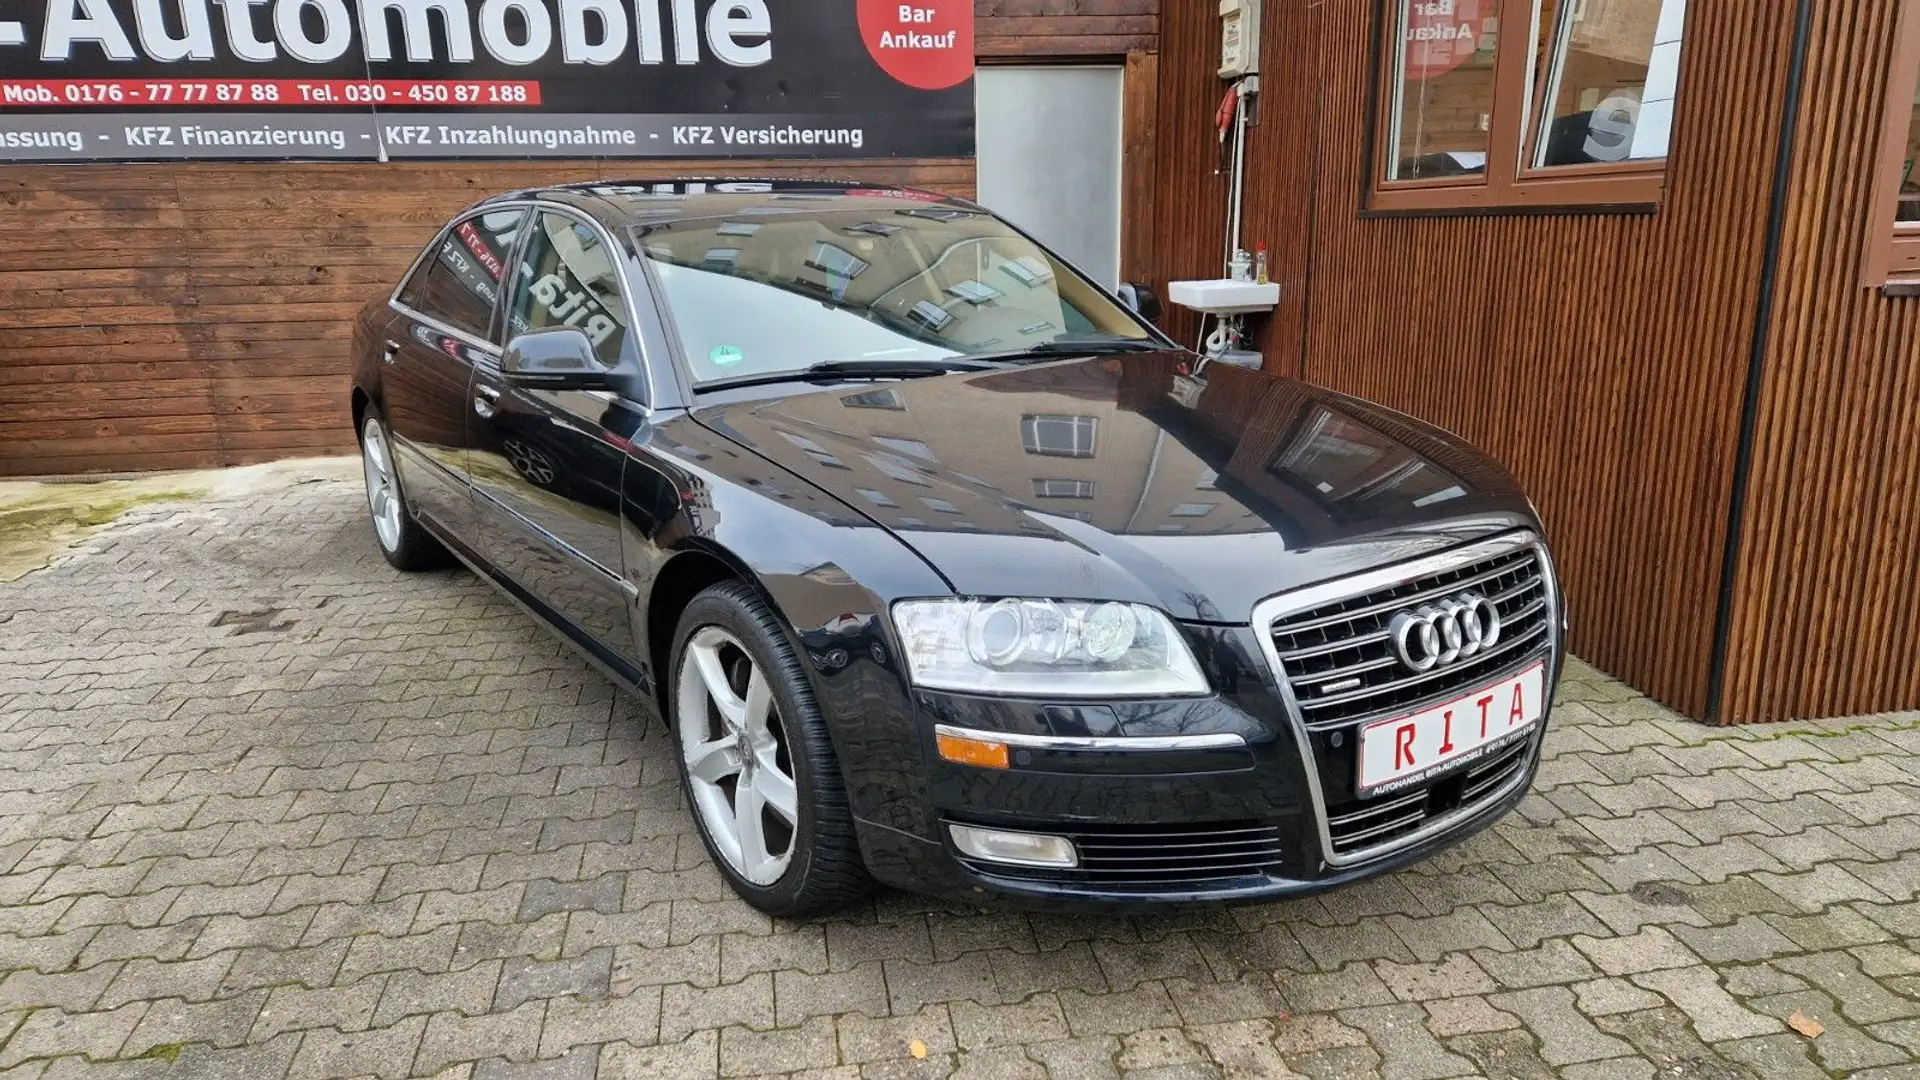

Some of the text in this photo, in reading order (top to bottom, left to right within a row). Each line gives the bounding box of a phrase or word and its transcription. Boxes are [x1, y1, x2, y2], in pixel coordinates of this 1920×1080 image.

[898, 4, 935, 22] Bar
[879, 30, 956, 48] Ankauf
[3, 84, 59, 102] Mob.
[65, 84, 123, 102] 0176
[145, 84, 173, 101] 77
[180, 84, 208, 101] 77
[215, 84, 243, 101] 87
[251, 84, 279, 101] 88
[297, 84, 339, 101] Tel.
[345, 84, 386, 102] 030
[408, 84, 448, 102] 450
[454, 84, 480, 101] 87
[488, 84, 527, 102] 188
[124, 126, 174, 147] KFZ
[180, 125, 345, 150] Finanzierung
[386, 125, 432, 145] KFZ
[438, 125, 635, 148] Inzahlungnahme
[672, 126, 715, 145] KFZ
[720, 125, 863, 148] Versicherung
[1394, 682, 1524, 771] RITA
